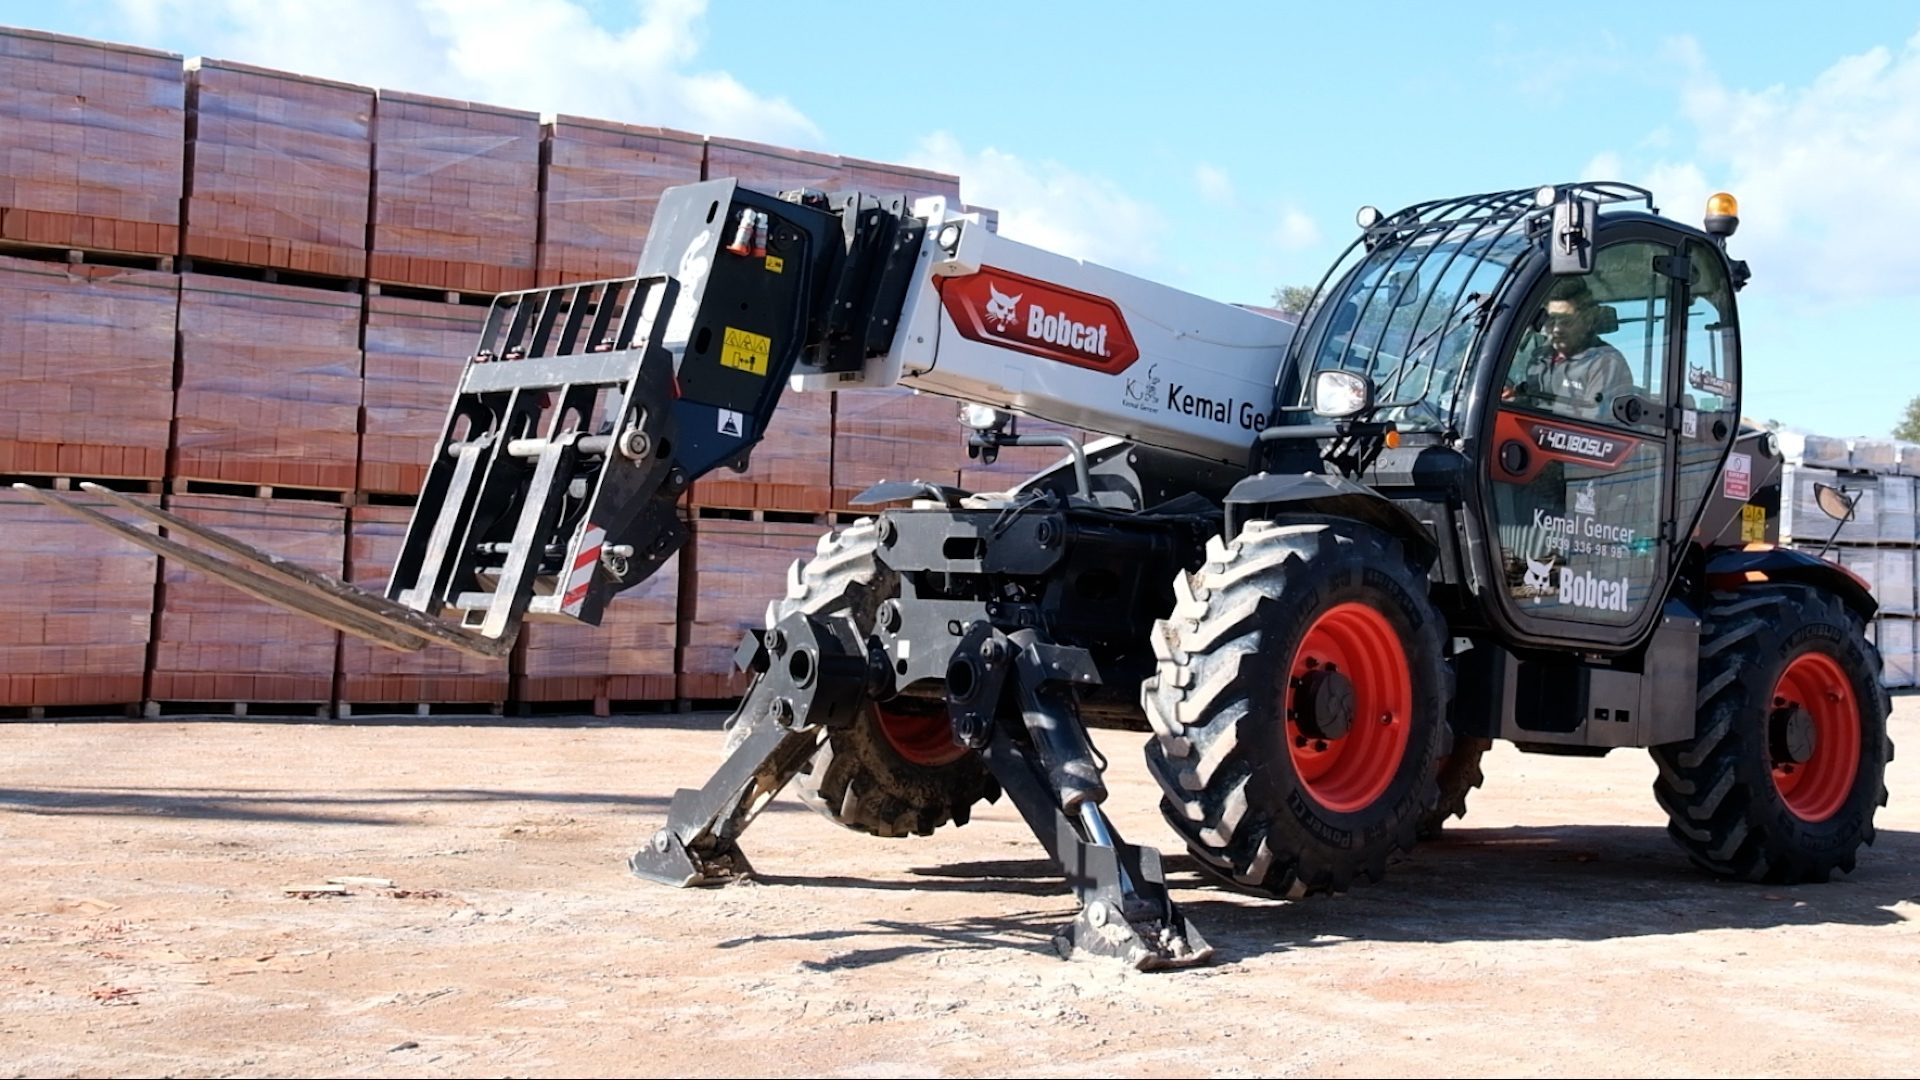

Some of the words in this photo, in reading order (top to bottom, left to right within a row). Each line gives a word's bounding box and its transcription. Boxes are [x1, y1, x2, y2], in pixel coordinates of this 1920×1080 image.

[1027, 304, 1108, 357] Bobcat
[1167, 382, 1232, 424] Kemal
[1240, 402, 1265, 433] Ge
[1534, 508, 1579, 535] Kemal
[1584, 517, 1635, 543] Gencer
[1574, 540, 1592, 554] 336
[1595, 544, 1607, 557] 98
[1559, 566, 1629, 612] Bobcat
